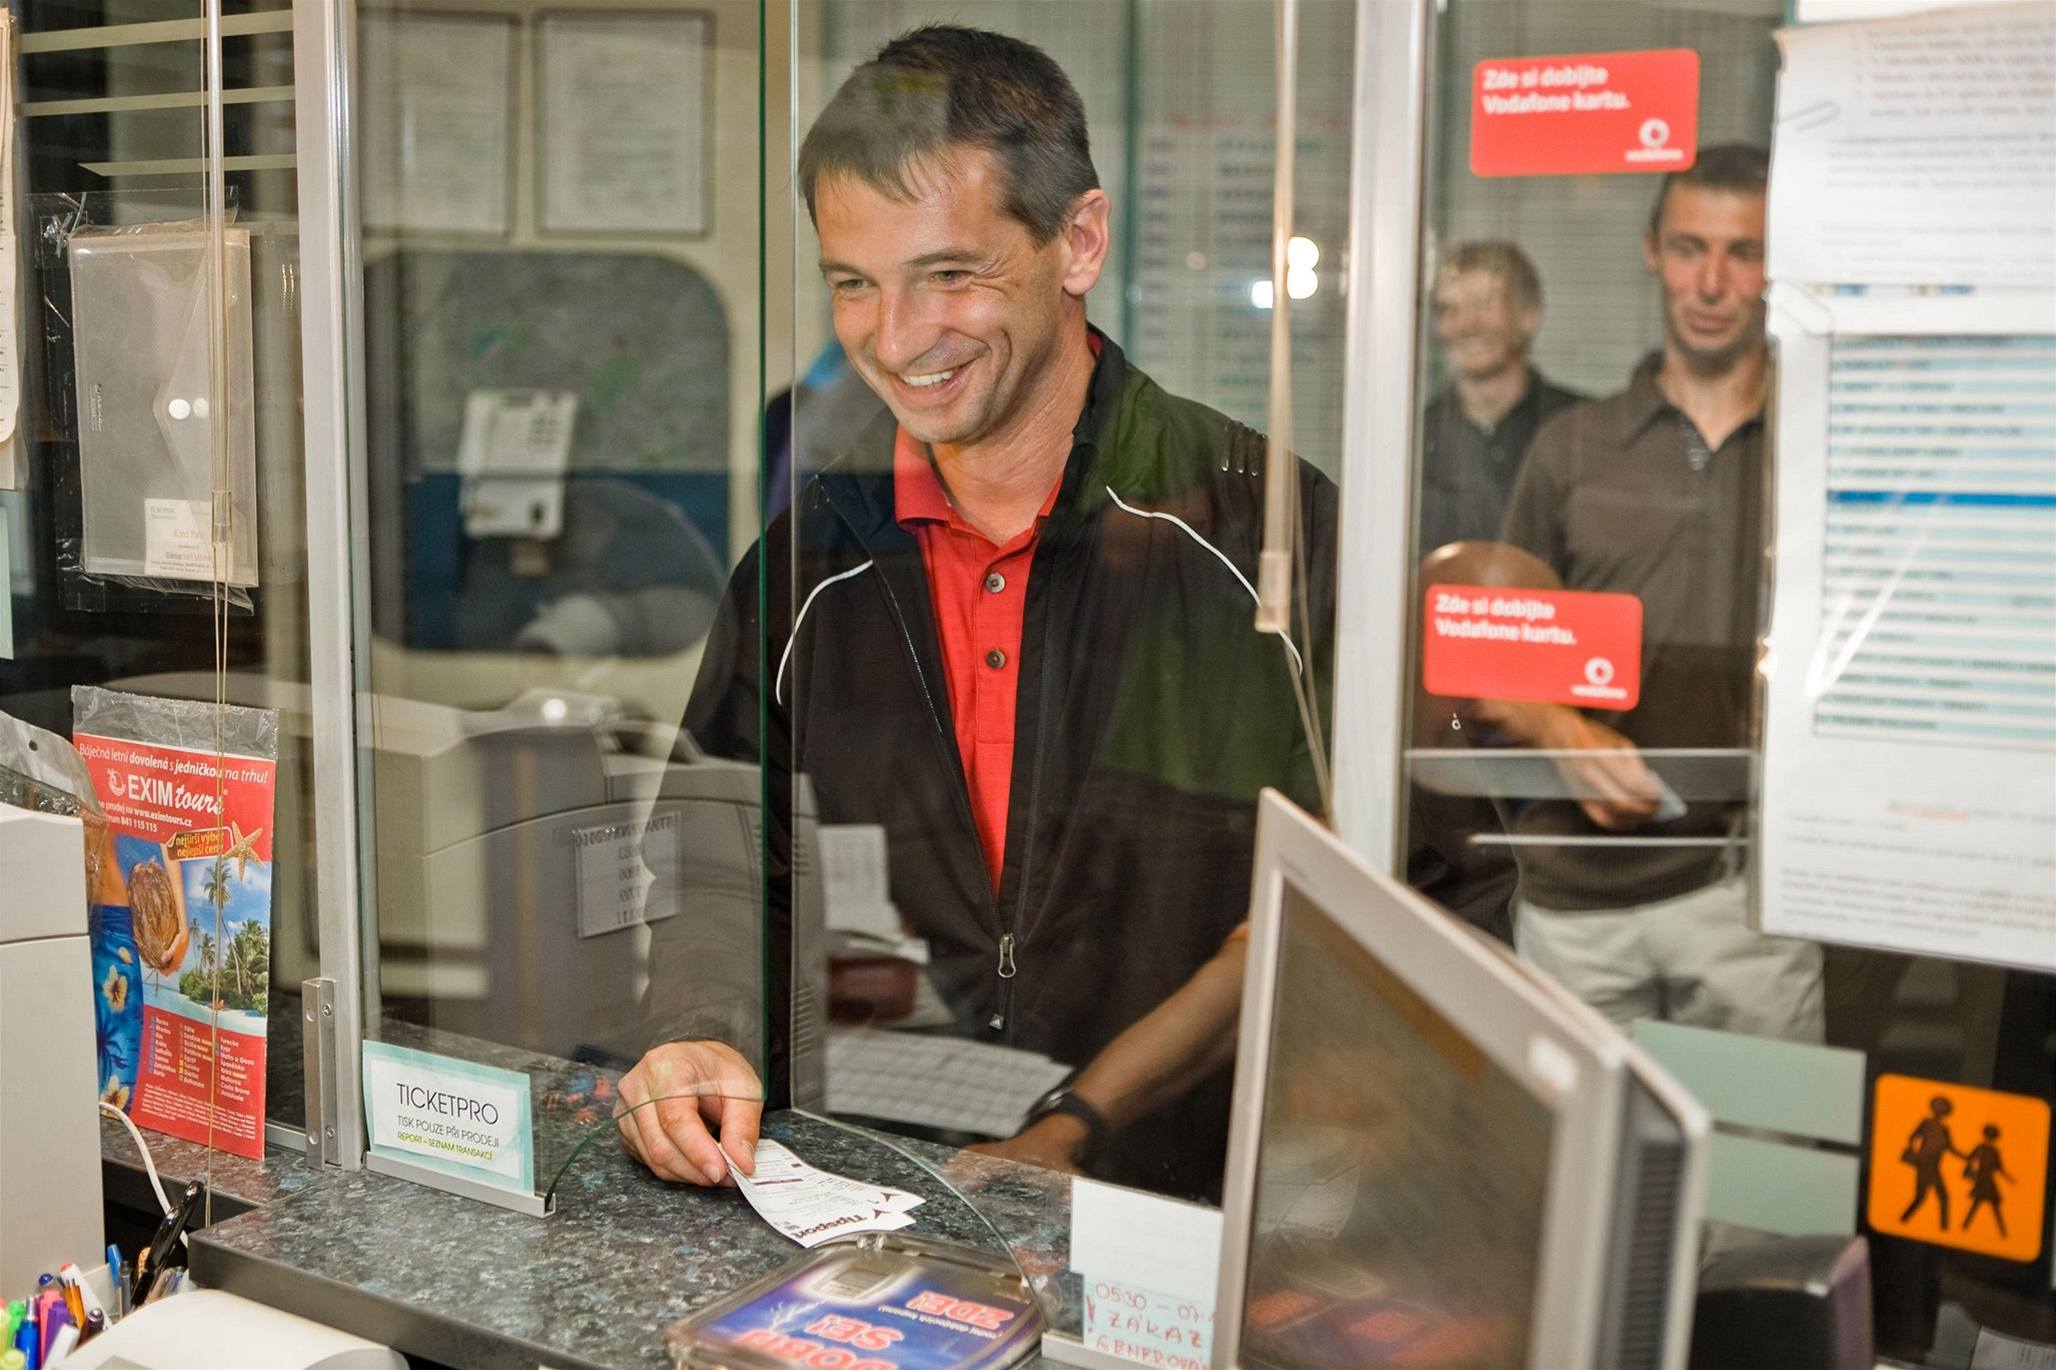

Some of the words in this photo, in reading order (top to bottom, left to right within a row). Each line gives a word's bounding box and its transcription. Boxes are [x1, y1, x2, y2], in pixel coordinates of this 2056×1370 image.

[1483, 69, 1518, 89] Zde
[1521, 68, 1538, 87] si
[1540, 65, 1608, 88] dobijte
[1482, 93, 1570, 114] Vodafone
[1572, 90, 1632, 110] kartu.
[1435, 593, 1469, 613] Zde
[1471, 598, 1488, 615] si
[1490, 598, 1556, 621] dobijte
[1435, 618, 1519, 640] Vodafone
[1521, 624, 1577, 645] kartu.
[80, 743, 110, 759] Báječná
[129, 752, 168, 770] dovolená
[169, 761, 174, 771] s
[225, 769, 239, 780] na
[241, 769, 269, 783] trhu!
[128, 774, 172, 807] EXIM
[134, 819, 145, 830] 115
[146, 822, 157, 832] 115
[396, 1083, 498, 1125] TICKETPRO
[397, 1115, 414, 1128] TISK
[416, 1119, 444, 1136] POUZE
[446, 1125, 460, 1138] PŘI
[428, 1138, 455, 1152] SEZNAM
[792, 1214, 867, 1239] Tipsport
[905, 1290, 1015, 1331] ZDE!
[804, 1313, 905, 1350] SE!
